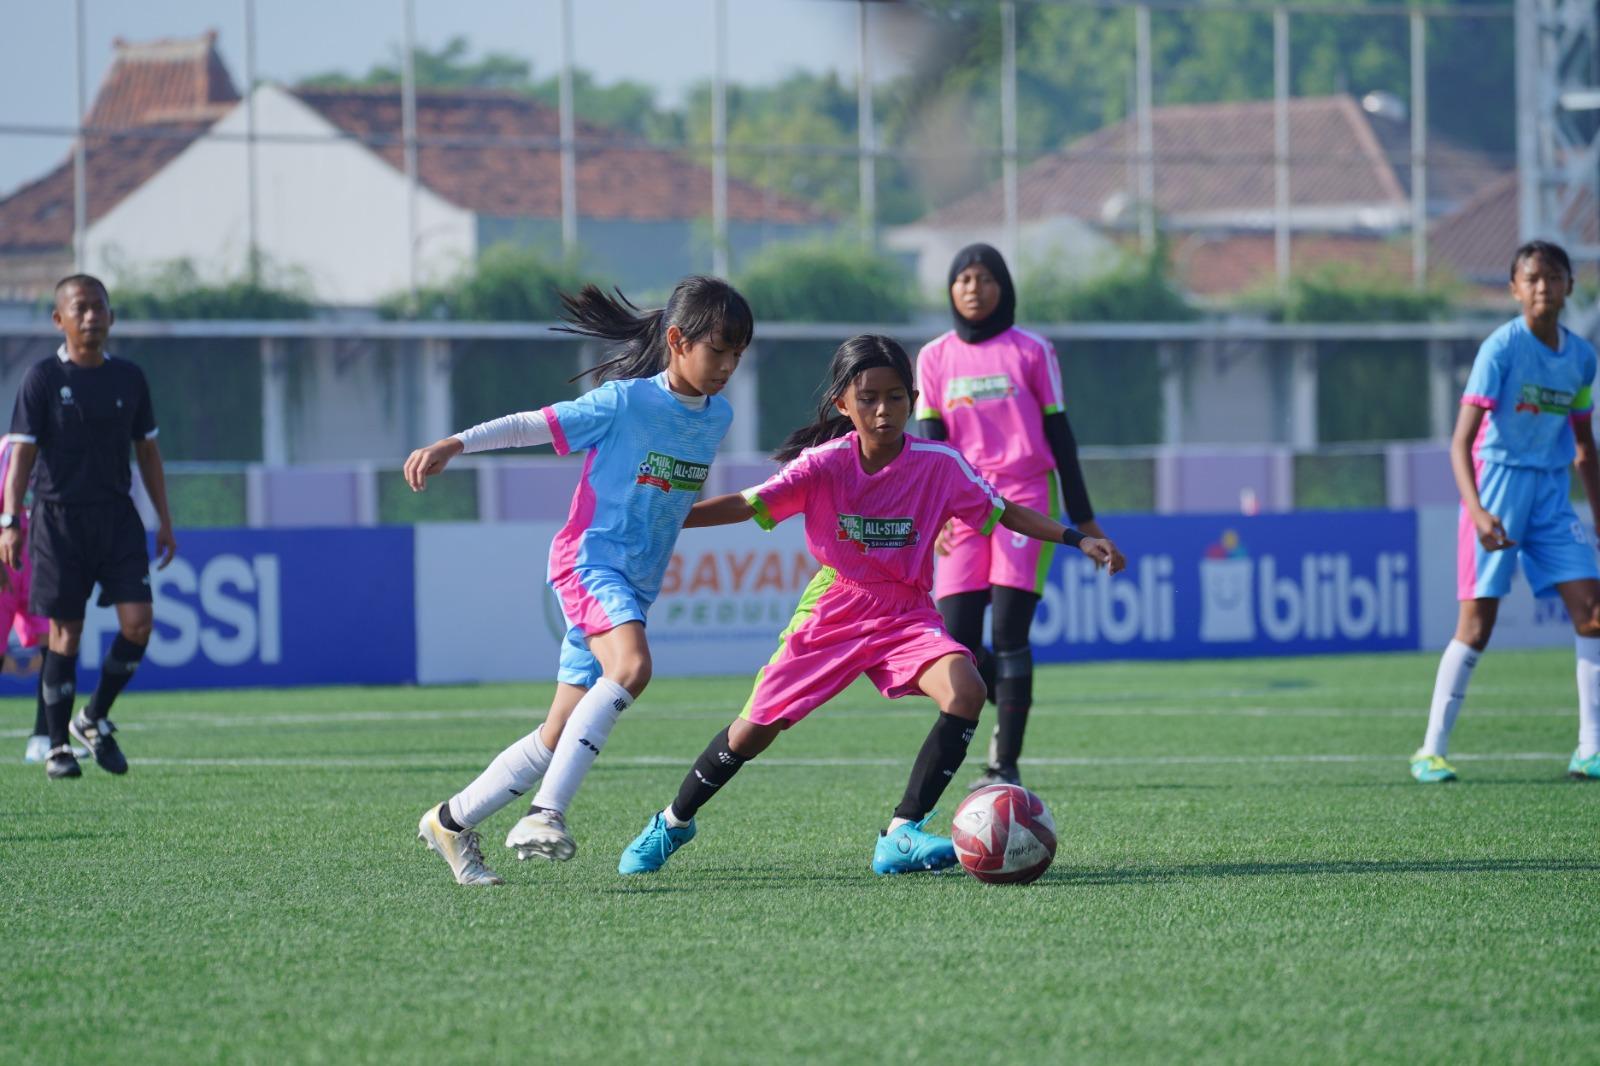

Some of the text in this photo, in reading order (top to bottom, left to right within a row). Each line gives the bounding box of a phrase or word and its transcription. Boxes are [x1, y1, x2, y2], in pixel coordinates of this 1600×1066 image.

[649, 453, 671, 469] Milk
[651, 465, 671, 480] Life
[1259, 552, 1410, 642] blibli
